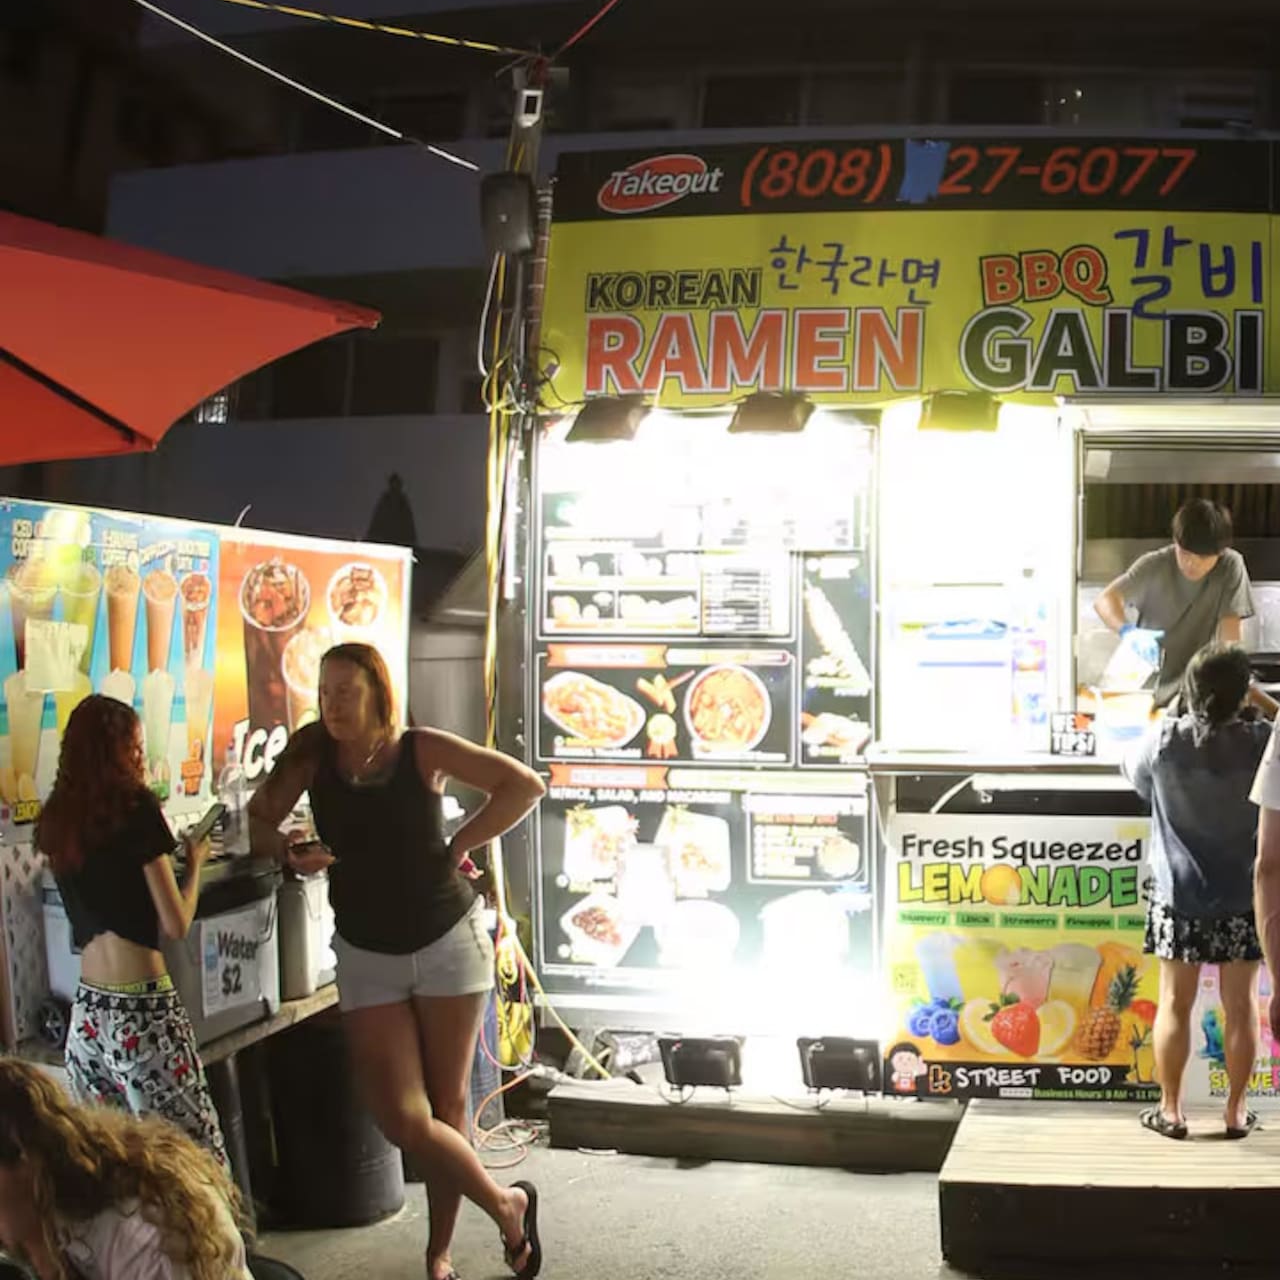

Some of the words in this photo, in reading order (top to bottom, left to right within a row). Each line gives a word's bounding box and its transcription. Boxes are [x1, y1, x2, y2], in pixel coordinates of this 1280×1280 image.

[609, 165, 723, 200] Takeout
[741, 146, 893, 207] (808)
[905, 147, 1197, 196] 27-6077
[586, 267, 761, 312] KOREAN
[769, 235, 941, 305] 한국라면
[980, 244, 1111, 307] BBQ
[1115, 225, 1265, 320] 갈비
[585, 308, 926, 395] RAMEN
[959, 308, 1265, 395] GALBI
[902, 834, 984, 859] Fresh
[992, 834, 1142, 865] Squeezed
[897, 862, 1139, 907] LEMONADE
[217, 929, 259, 963] Water
[222, 965, 242, 996] $2
[955, 1067, 1041, 1088] STREET
[1059, 1066, 1111, 1084] FOOD
[1034, 1089, 1073, 1099] Business
[1209, 1071, 1273, 1089] SVE
